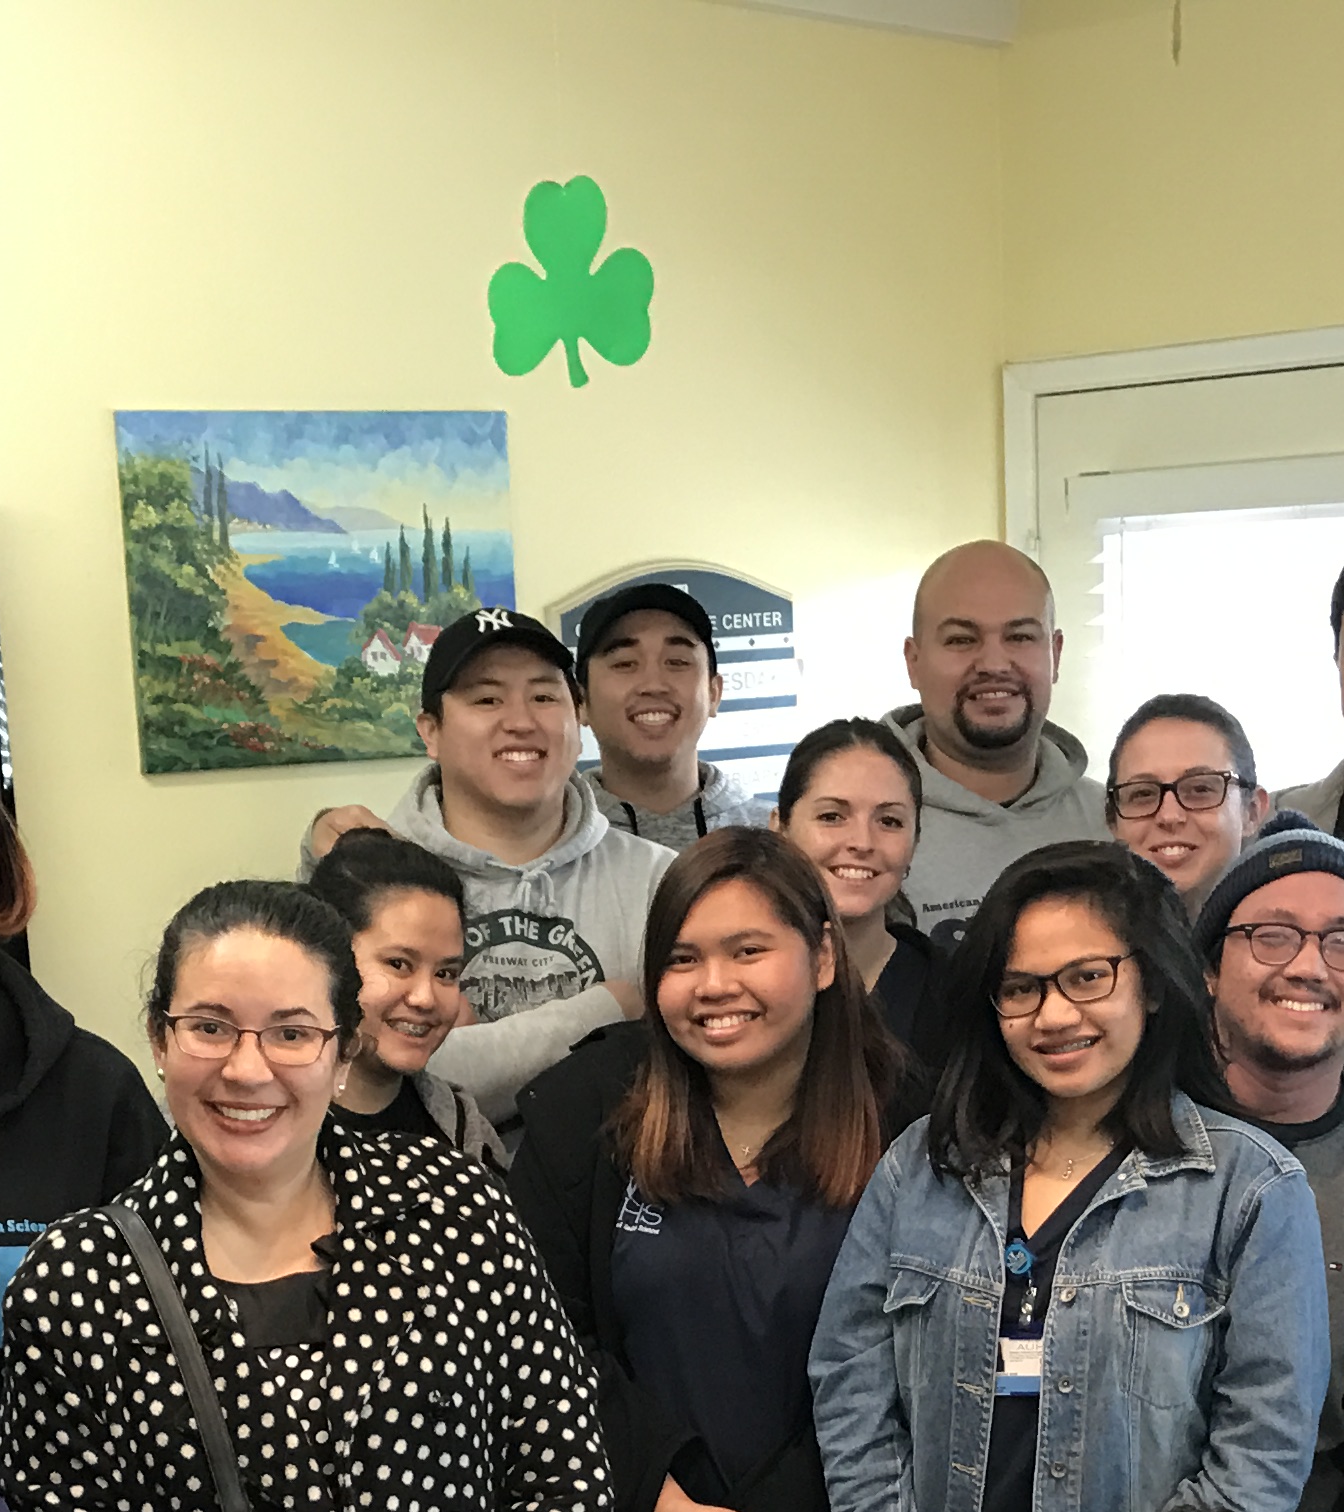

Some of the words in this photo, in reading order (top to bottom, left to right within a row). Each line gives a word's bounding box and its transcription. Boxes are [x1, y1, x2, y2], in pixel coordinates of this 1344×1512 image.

[474, 607, 515, 634] NY
[722, 611, 783, 629] CENTER
[465, 922, 491, 948] OF
[497, 915, 540, 941] THE
[531, 954, 555, 968] CITY
[6, 1218, 48, 1233] Scien
[1016, 1343, 1043, 1351] AUH
